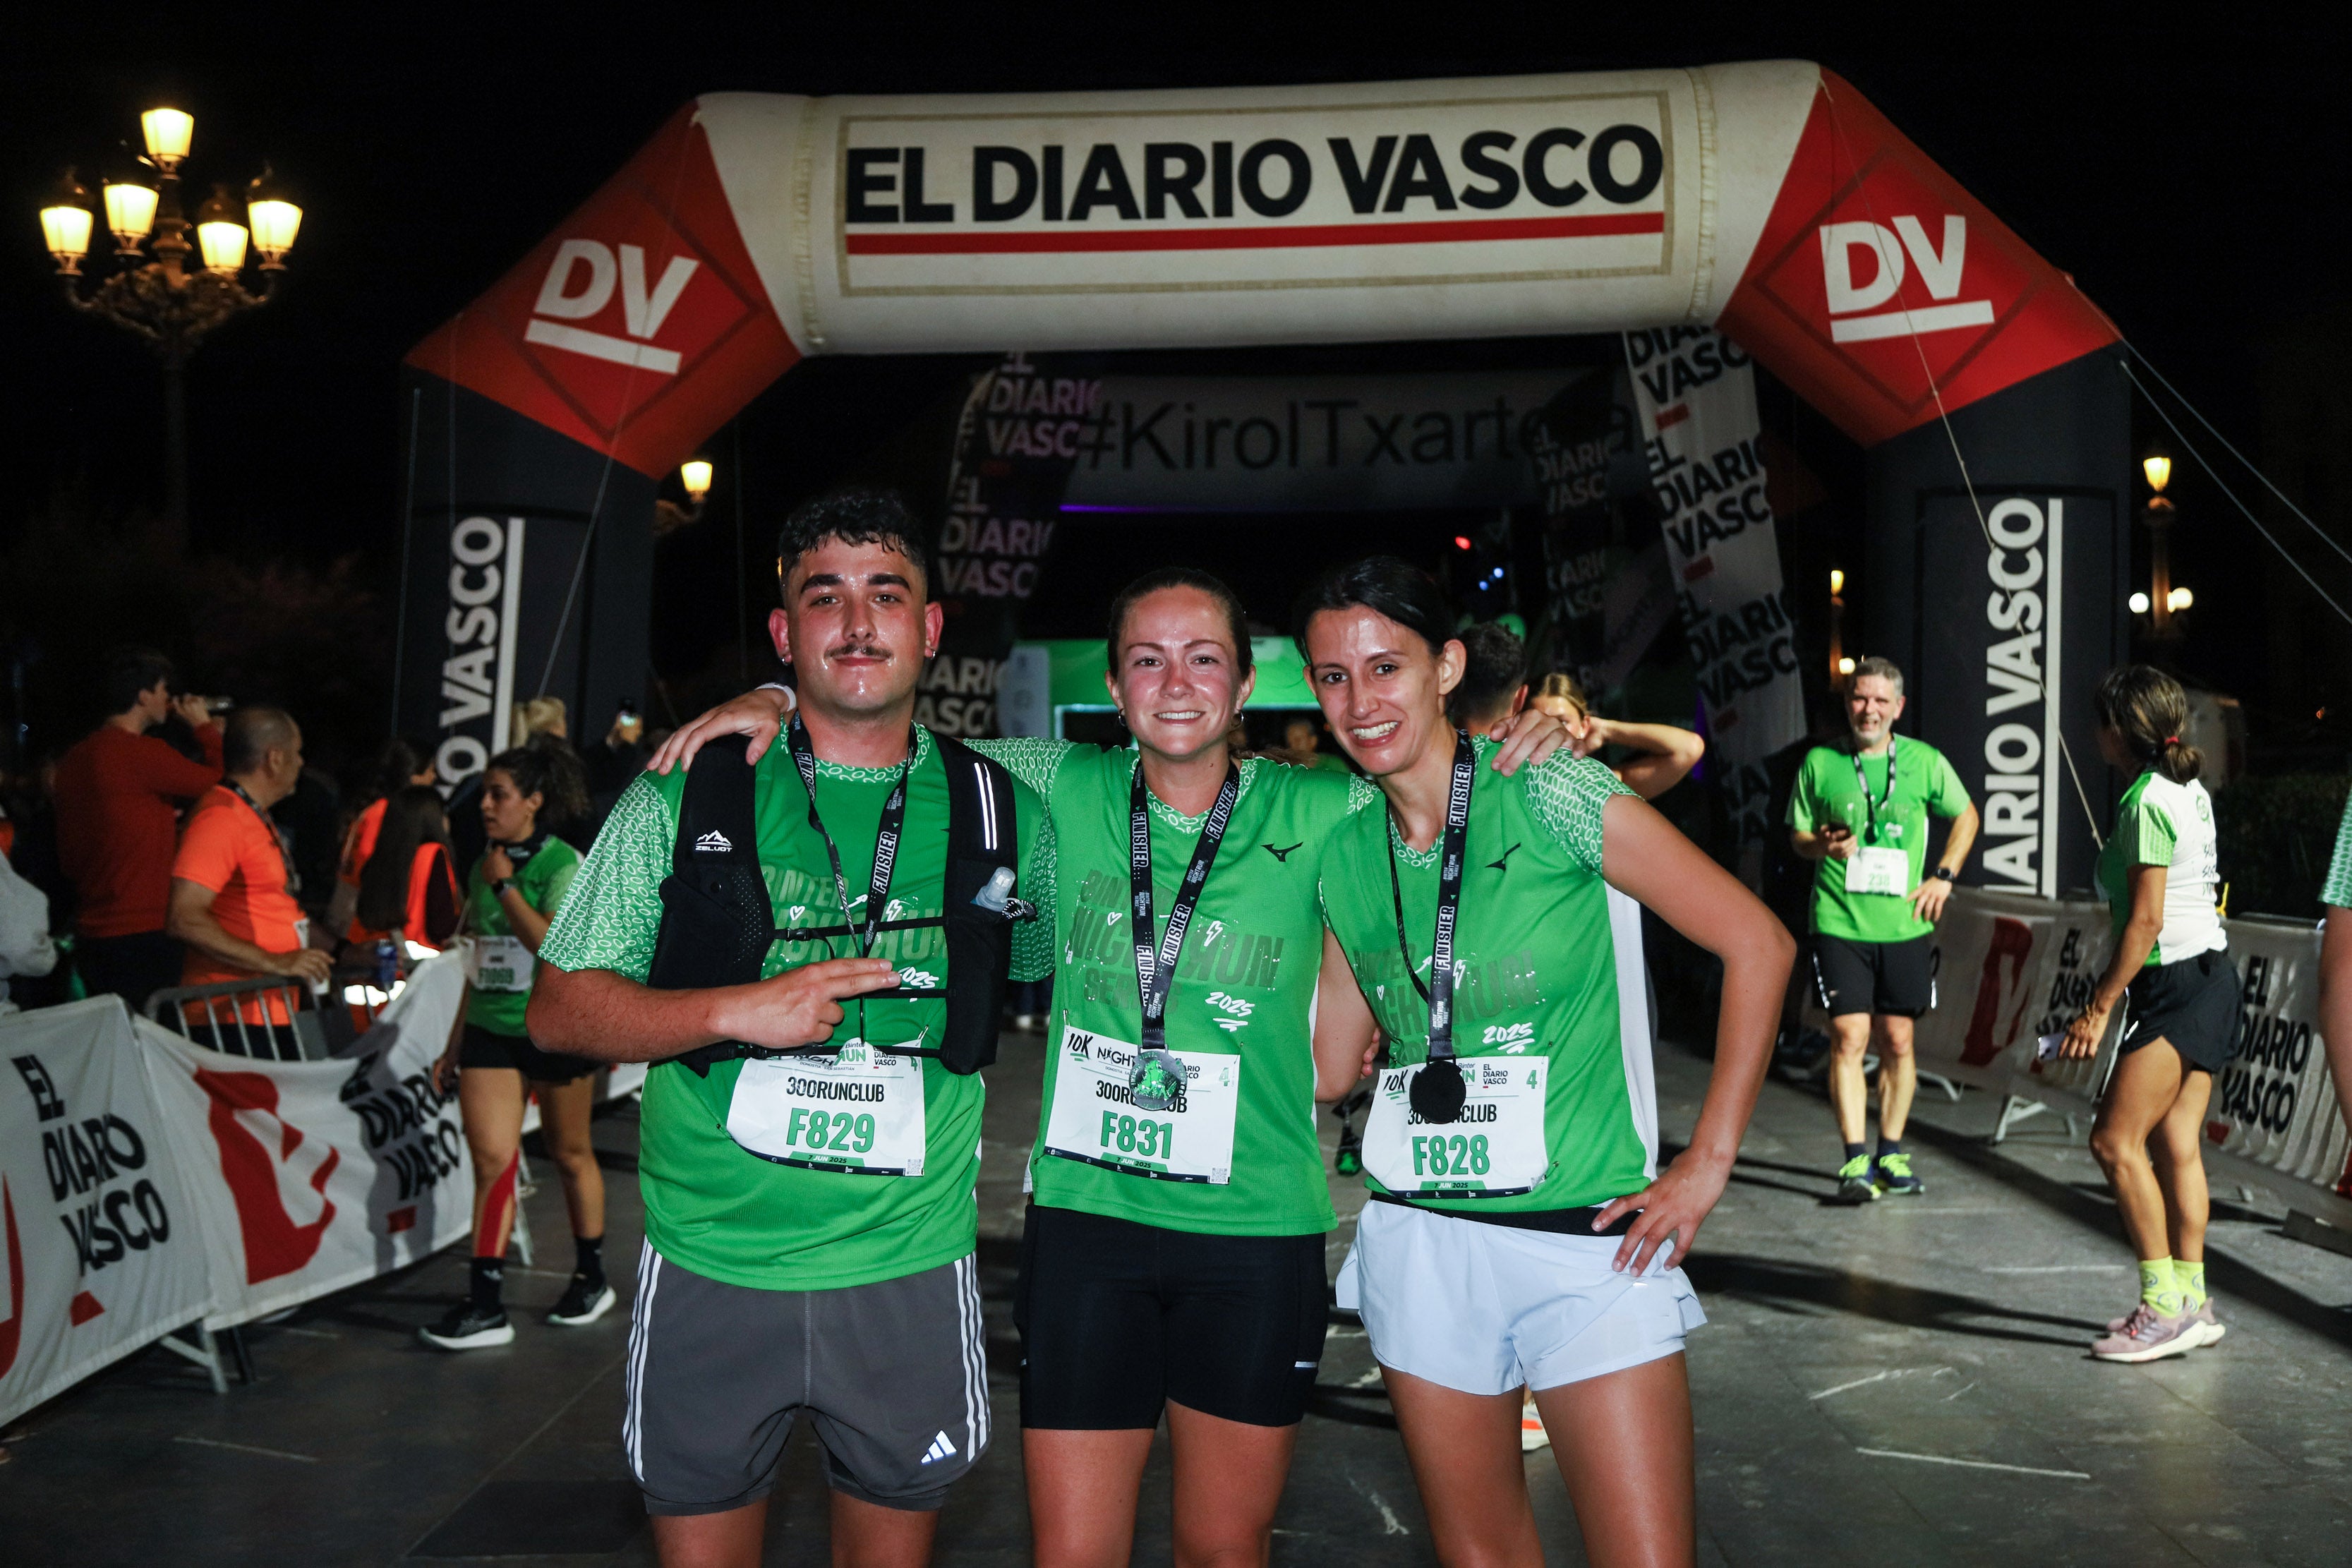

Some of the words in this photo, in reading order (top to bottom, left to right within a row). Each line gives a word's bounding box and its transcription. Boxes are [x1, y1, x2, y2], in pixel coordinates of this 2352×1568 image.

[847, 147, 954, 224] EL
[973, 138, 1312, 222] DIARIO
[1327, 123, 1664, 215] VASCO
[533, 239, 700, 340] DV
[1819, 215, 1966, 314] DV
[438, 516, 505, 728] VASCO
[1986, 497, 2044, 716] VASCO
[1205, 781, 1236, 839] FINISHER
[1449, 764, 1471, 826] FINISHER
[872, 831, 897, 894] FINISHER
[1132, 812, 1148, 867] FINISHER
[1159, 903, 1192, 966] FINISHER
[1435, 905, 1454, 970] FINISHER
[1205, 991, 1255, 1017] 2025
[2243, 955, 2268, 1007] EL
[1066, 1032, 1093, 1061] 10K
[1482, 1022, 1533, 1044] 2025
[11, 1054, 64, 1121] EL
[786, 1077, 885, 1102] 300RUNCLUB
[1219, 1067, 1230, 1087] 4
[1382, 1069, 1408, 1094] 10K
[1526, 1070, 1538, 1089] 4
[2221, 1066, 2295, 1134] VASCO
[786, 1107, 876, 1152] F829
[1100, 1110, 1173, 1159] F831
[1412, 1135, 1490, 1176] F828
[1135, 1160, 1152, 1169] 2025
